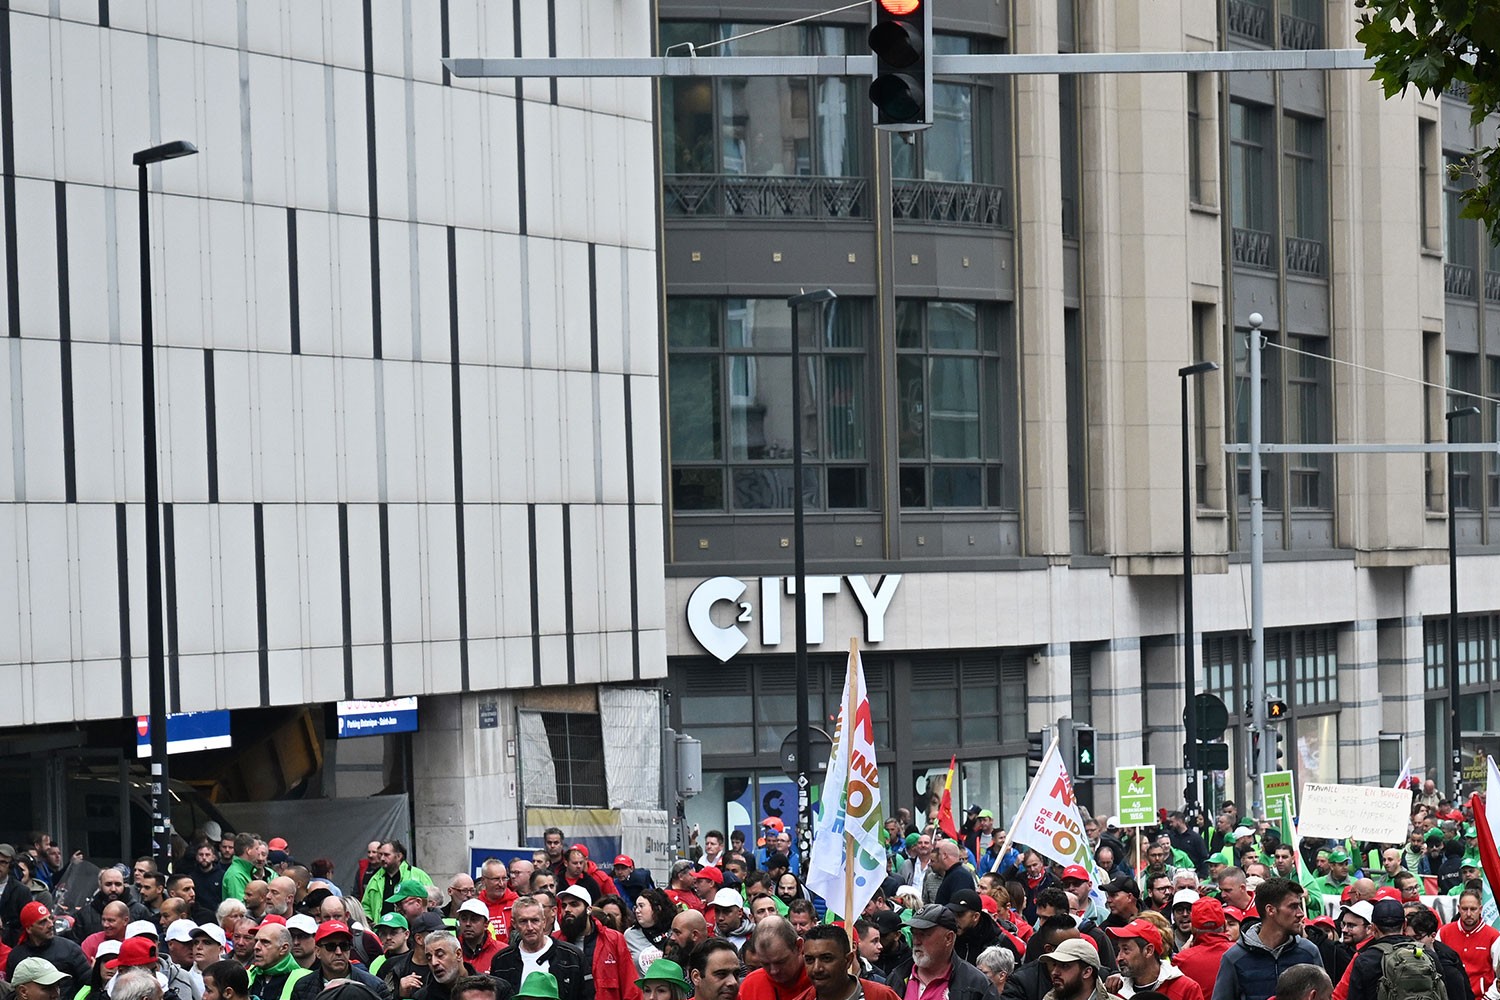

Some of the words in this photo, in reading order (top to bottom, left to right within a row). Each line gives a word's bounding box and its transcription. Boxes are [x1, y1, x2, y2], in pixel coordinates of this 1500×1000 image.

[1040, 807, 1053, 818] DE
[1035, 815, 1045, 825] IS
[1033, 823, 1053, 837] VAN
